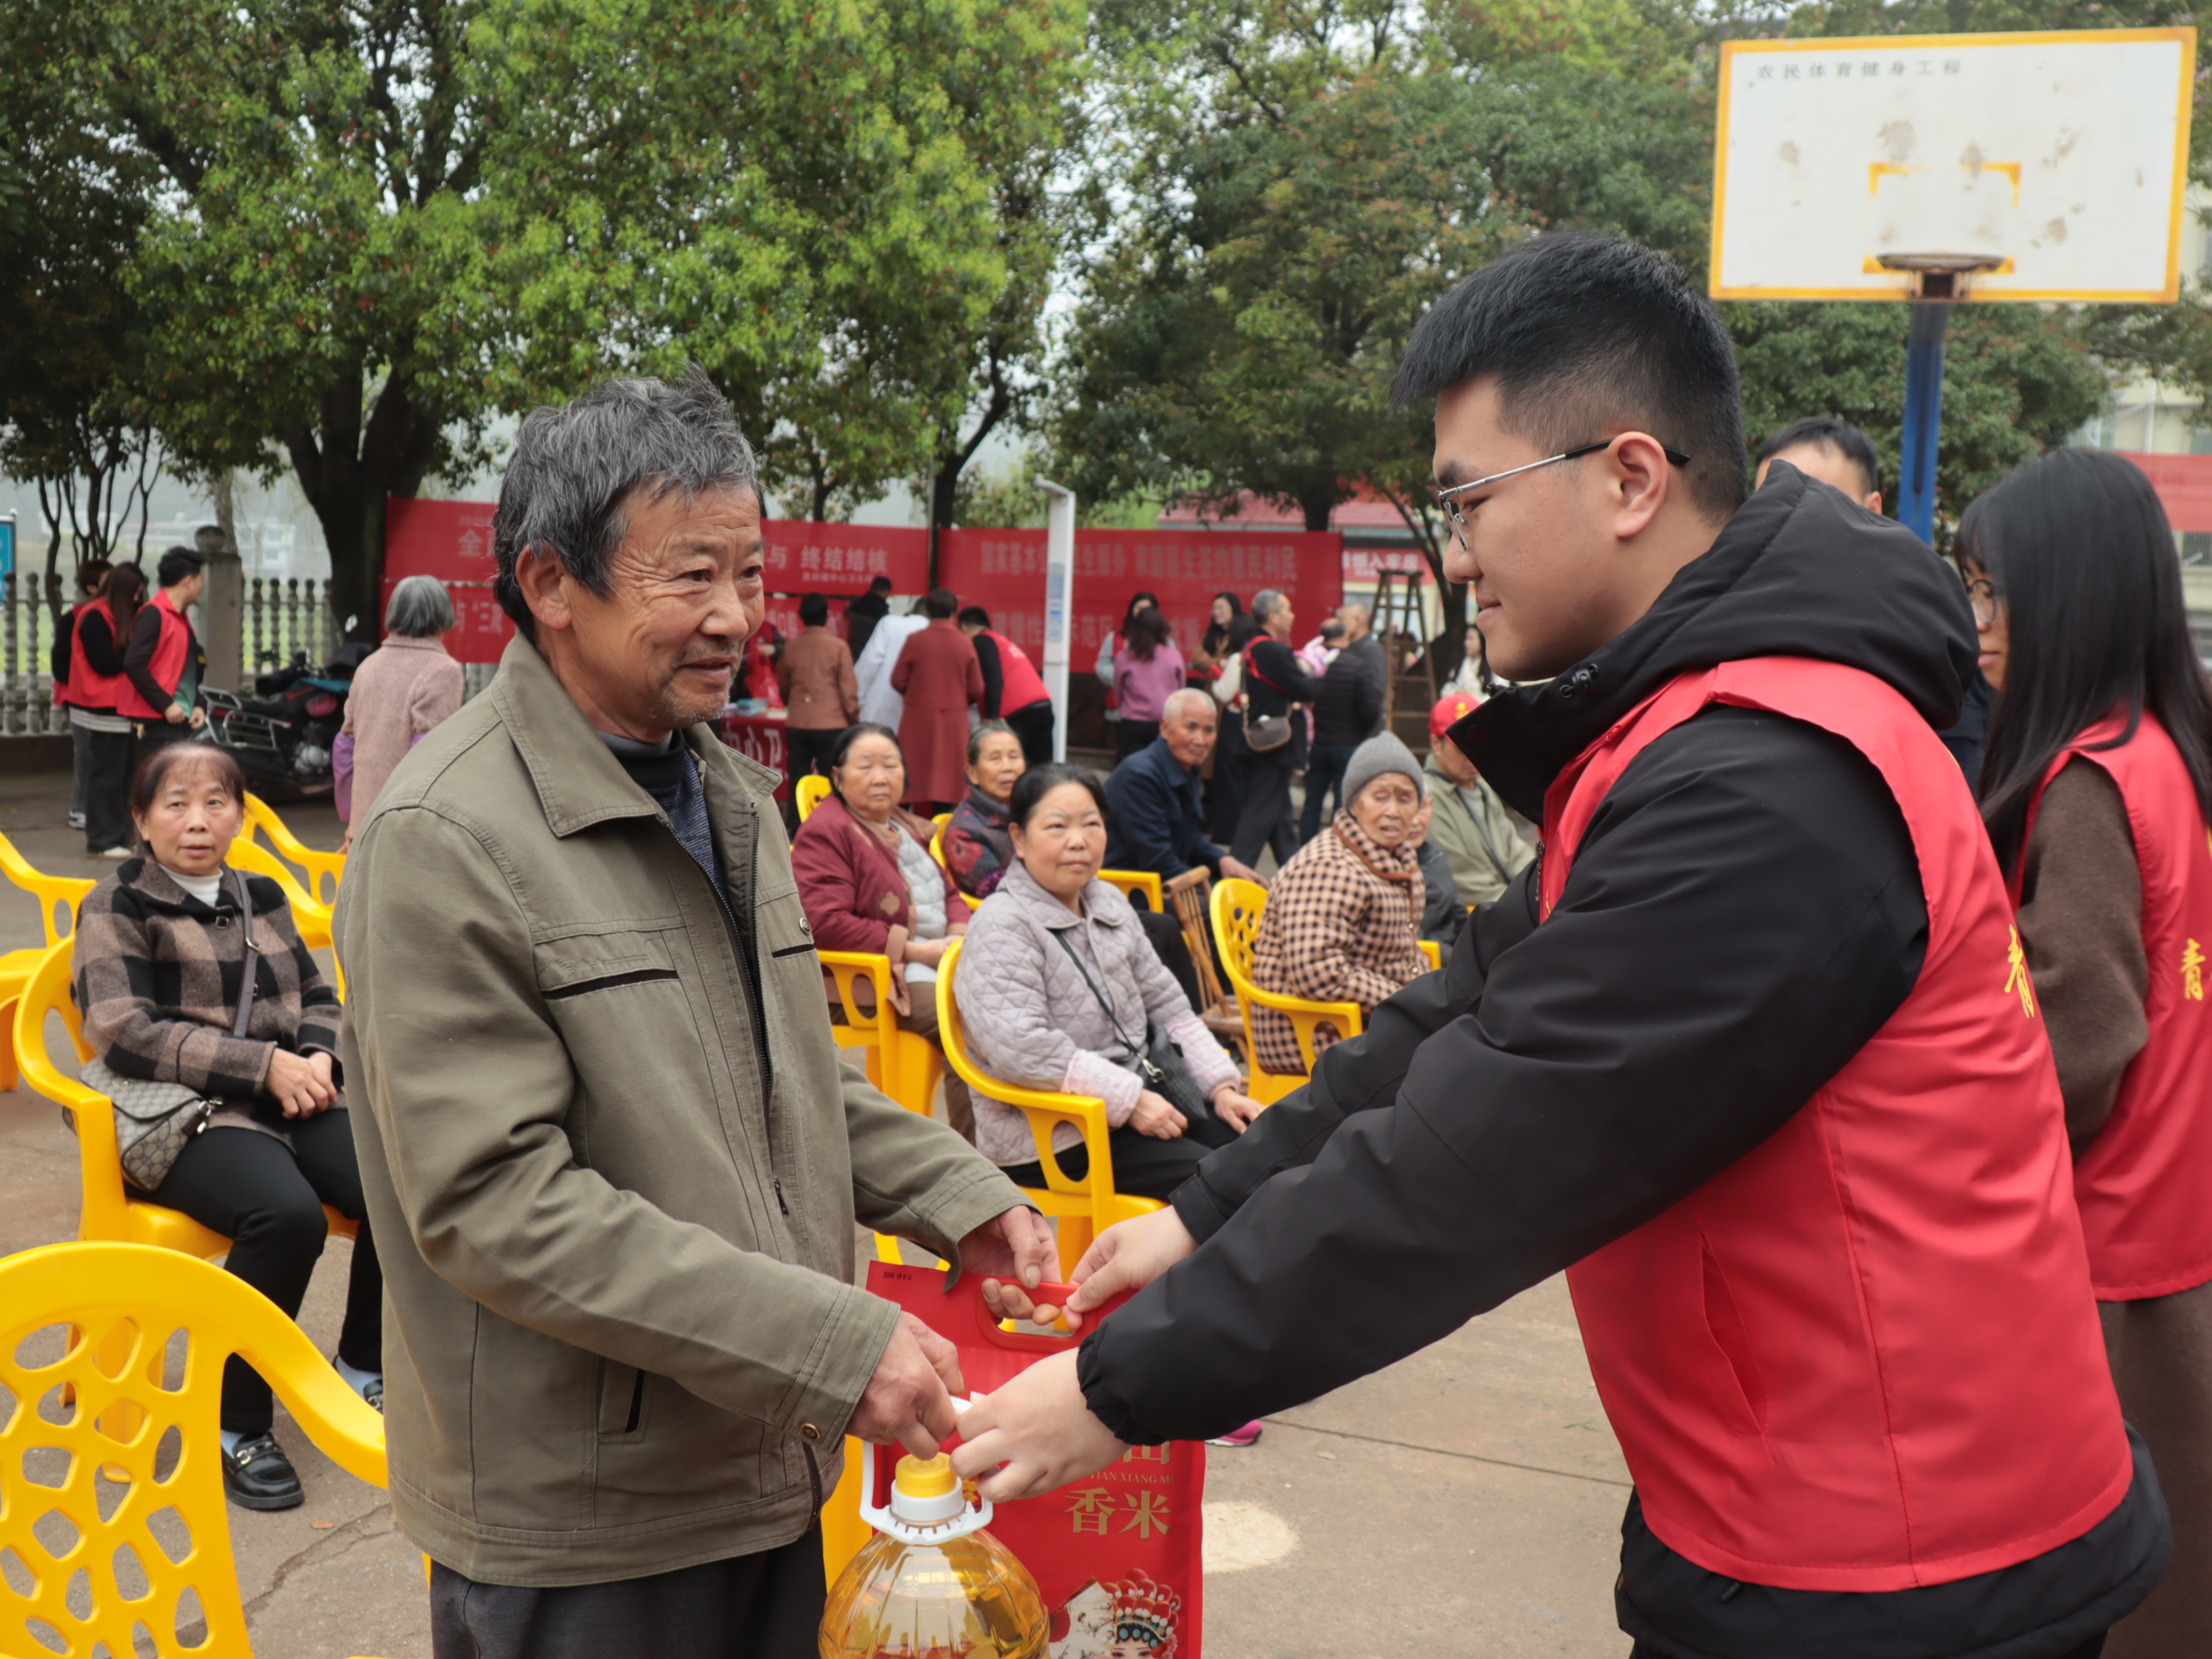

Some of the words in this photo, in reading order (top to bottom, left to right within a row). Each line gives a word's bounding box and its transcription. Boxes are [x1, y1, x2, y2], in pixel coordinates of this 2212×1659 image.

[1756, 59, 1962, 79] 农民体育健身工程
[800, 545, 888, 573] 终结结核
[981, 541, 1125, 576] 国家基本生服务
[2180, 938, 2207, 1001] 青
[1120, 1472, 1158, 1484] XIANG
[1064, 1487, 1172, 1539] 香米
